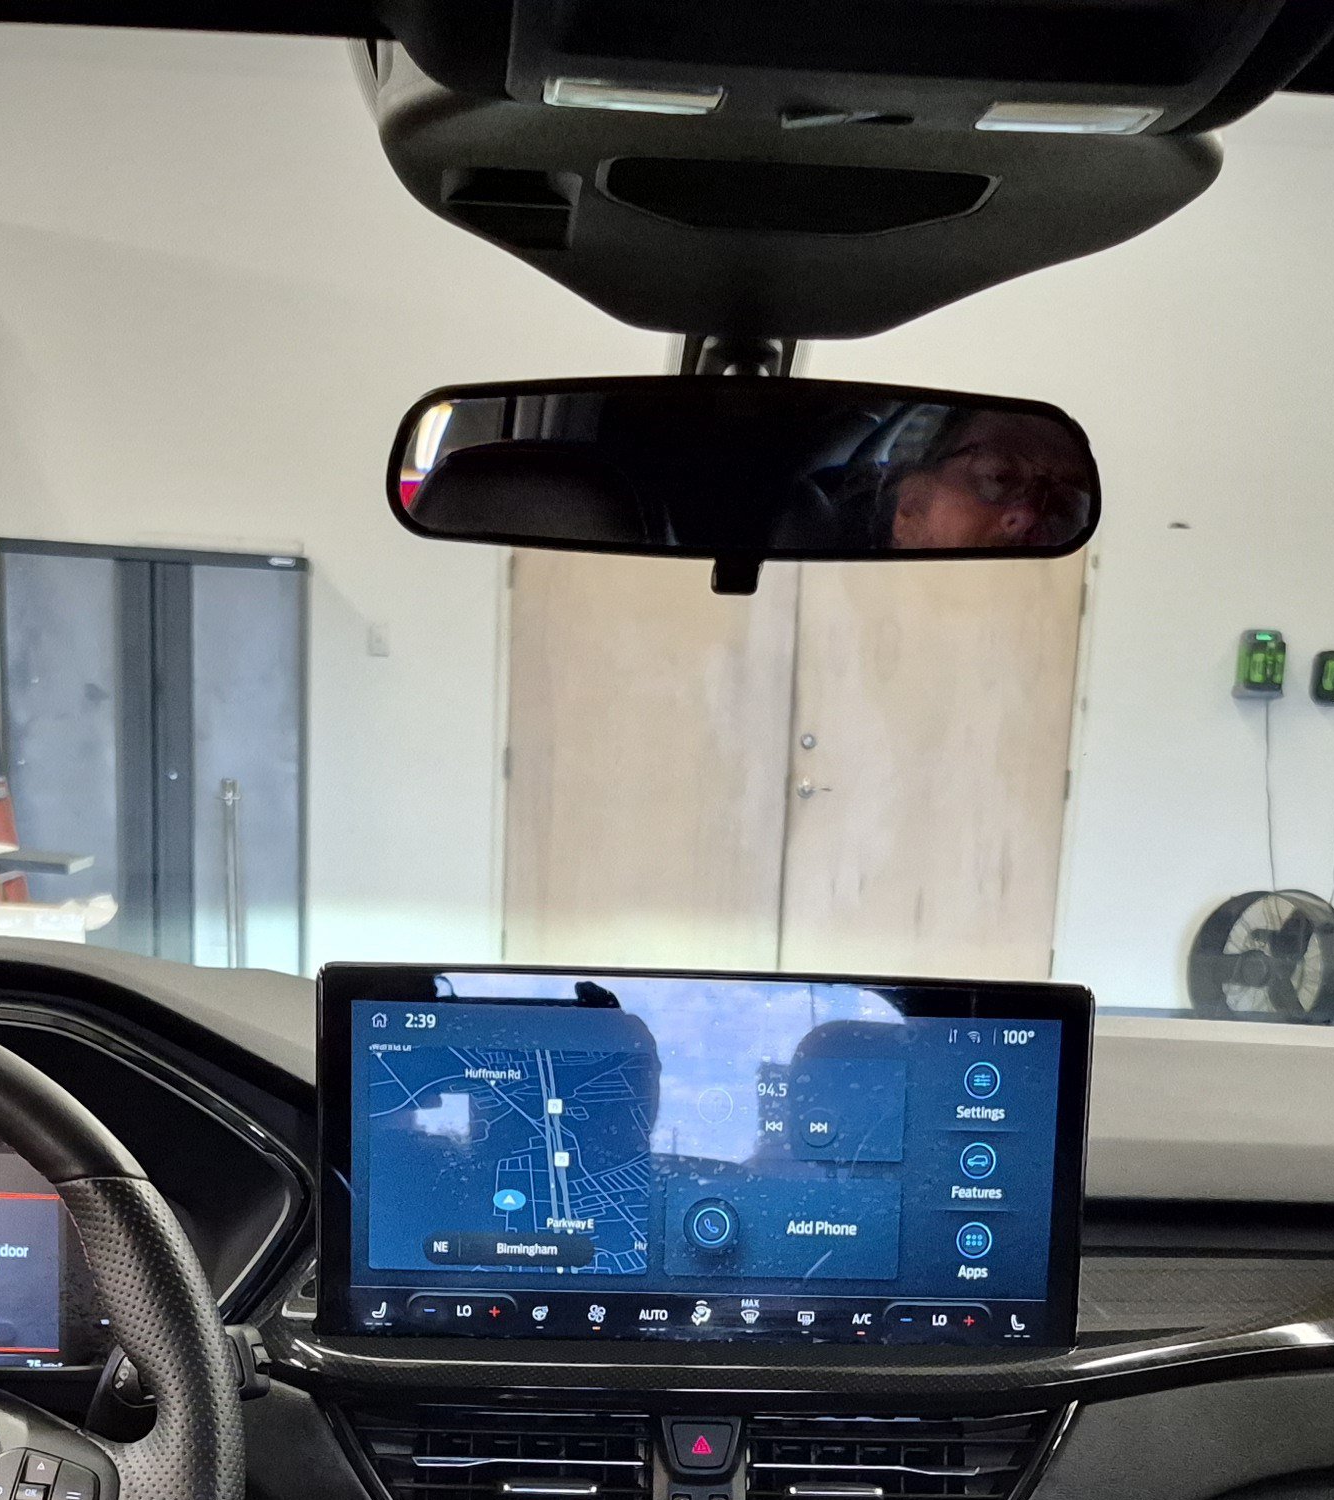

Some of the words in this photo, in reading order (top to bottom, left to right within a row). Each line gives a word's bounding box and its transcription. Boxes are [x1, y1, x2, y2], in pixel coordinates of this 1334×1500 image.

[404, 1013, 437, 1029] 2:39
[464, 1068, 506, 1080] Huffman
[507, 1068, 521, 1080] Rd
[757, 1082, 788, 1097] 94.5
[955, 1105, 1006, 1122] Settings
[950, 1185, 1003, 1199] Features
[546, 1217, 586, 1230] Parkway
[786, 1220, 813, 1236] Add
[815, 1220, 858, 1236] Phone
[0, 1243, 29, 1258] door
[432, 1241, 449, 1253] NE
[496, 1242, 558, 1257] Birmingham
[957, 1264, 989, 1279] Apps
[741, 1298, 760, 1309] MAX
[456, 1305, 472, 1317] LO
[638, 1308, 669, 1322] AUTO
[851, 1312, 872, 1325] A/C
[932, 1314, 948, 1326] LO
